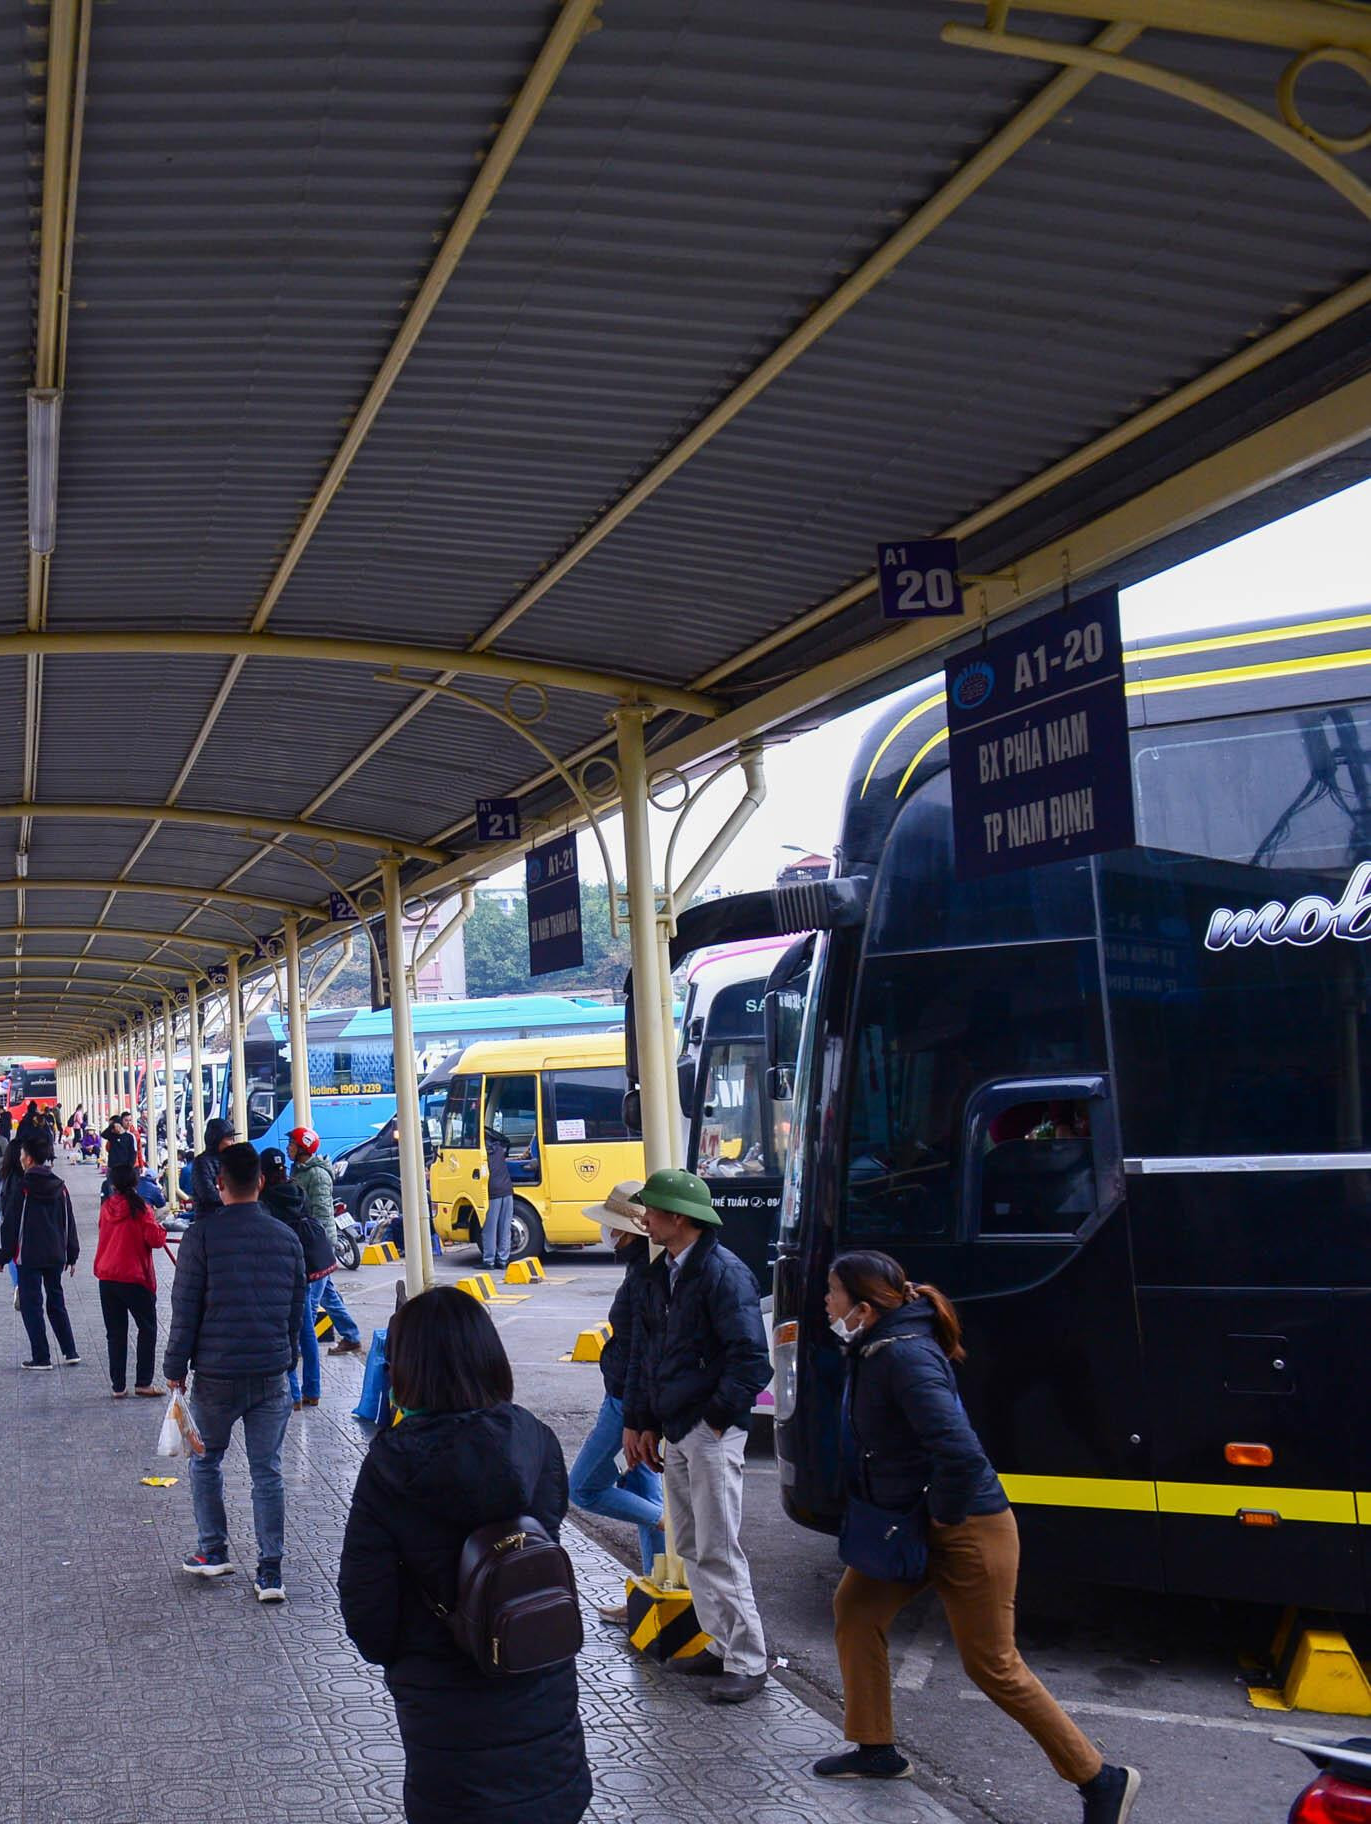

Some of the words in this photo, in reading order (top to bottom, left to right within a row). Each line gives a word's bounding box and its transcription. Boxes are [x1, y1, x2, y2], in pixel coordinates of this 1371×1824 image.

[884, 548, 907, 566] A1
[896, 568, 954, 611] 20
[979, 741, 1001, 784] BX
[1003, 721, 1043, 777] PHÍA
[1045, 711, 1089, 764] NAM
[488, 814, 516, 837] 21
[984, 811, 1003, 853] TP
[1008, 801, 1046, 849] NAM
[1049, 787, 1095, 845] ĐỊNH
[1204, 861, 1371, 951] mob
[340, 1084, 360, 1094] 1900
[727, 1195, 748, 1207] TUẤN
